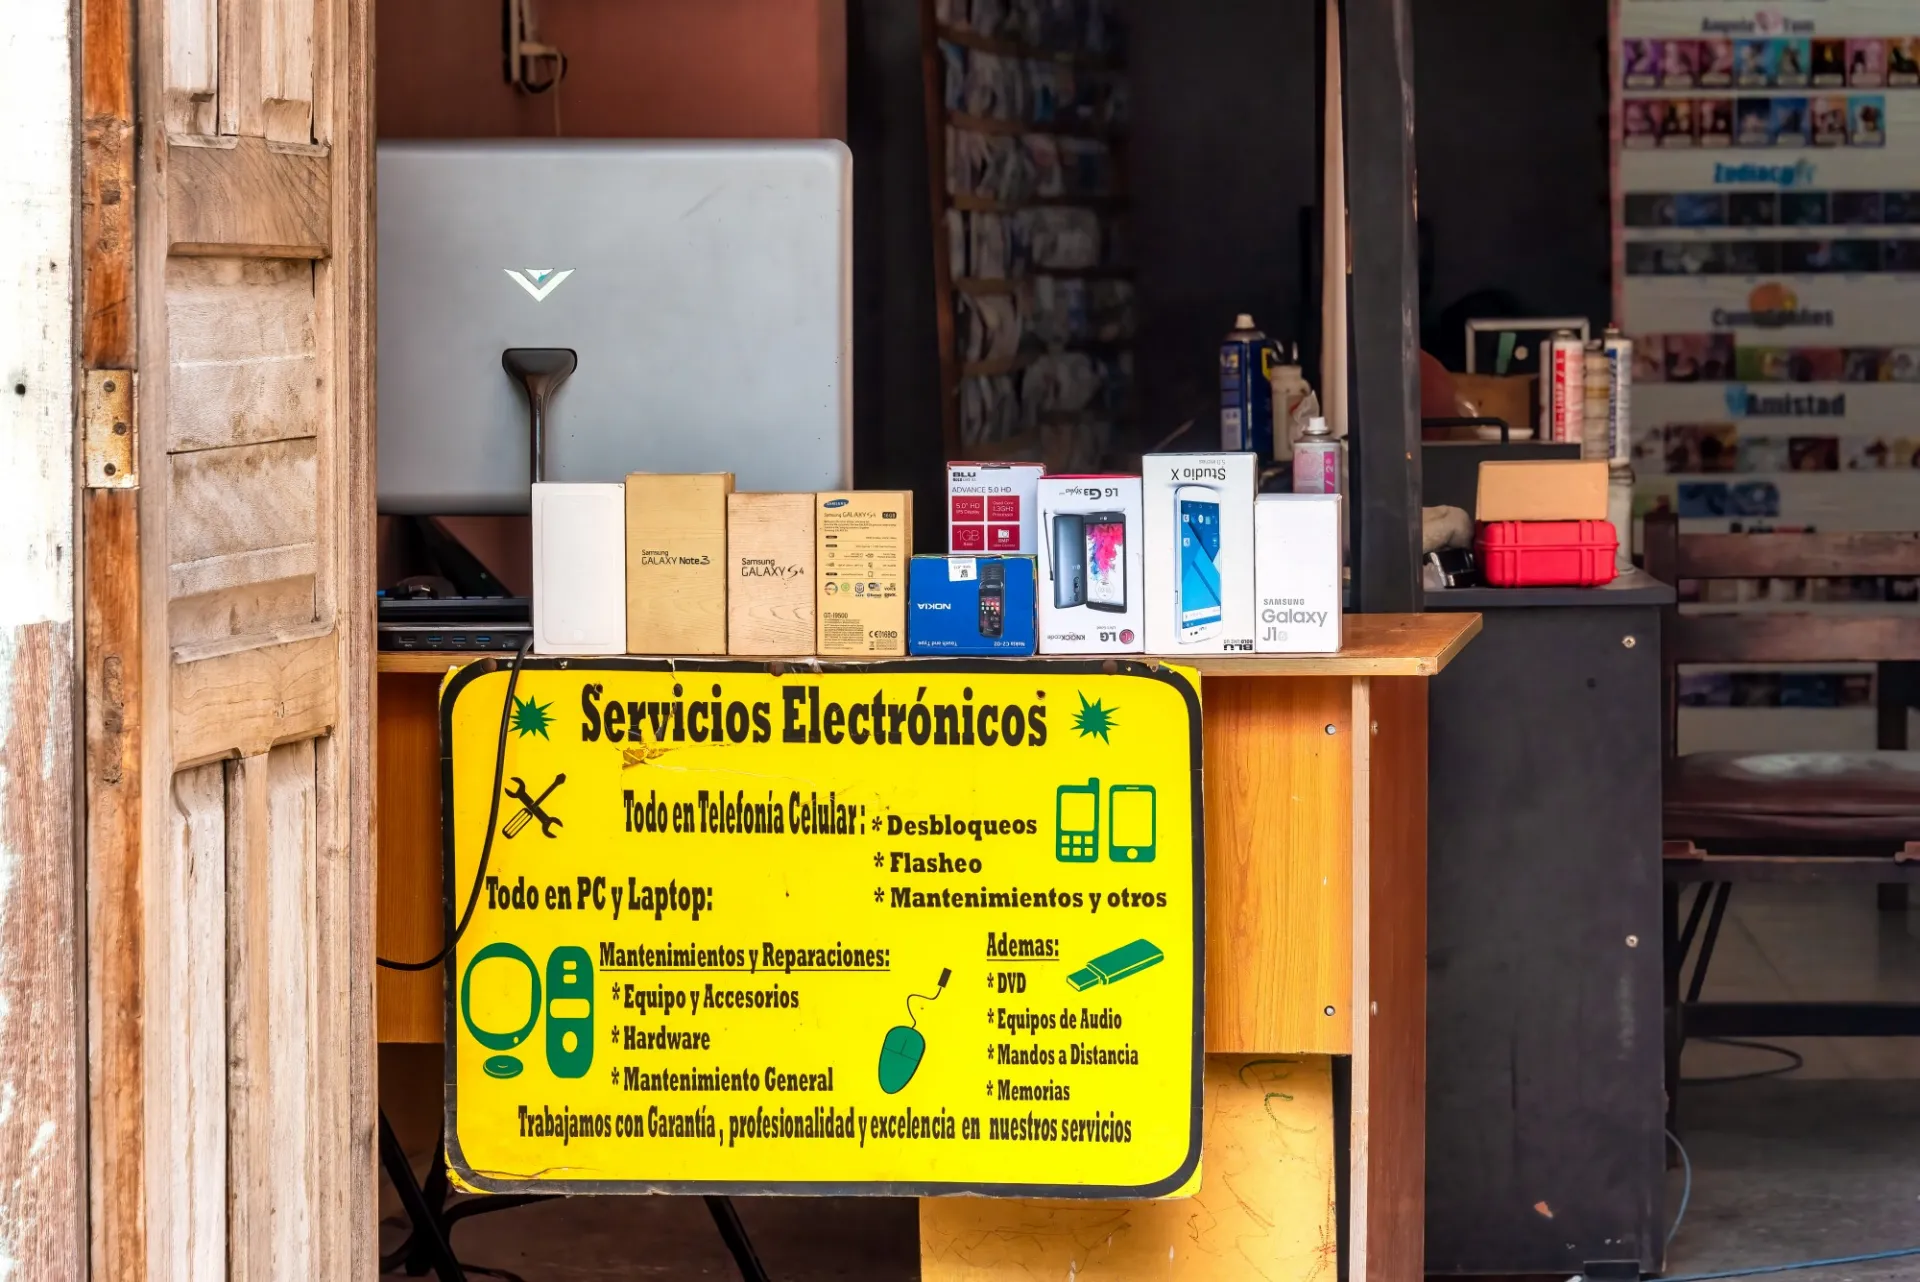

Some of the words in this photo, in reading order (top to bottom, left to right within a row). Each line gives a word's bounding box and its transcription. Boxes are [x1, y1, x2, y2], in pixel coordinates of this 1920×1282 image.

[1746, 393, 1845, 416] Amistad
[1171, 468, 1180, 480] X
[1183, 467, 1226, 480] Studio
[1083, 488, 1102, 500] G3
[1105, 488, 1119, 497] LG
[957, 530, 980, 541] 1GB
[641, 549, 669, 557] Samsung
[641, 557, 677, 565] GALAXY
[741, 557, 775, 567] Samsung
[741, 566, 786, 577] GALAXY
[1261, 609, 1328, 626] Galaxy
[1100, 632, 1117, 642] LG
[582, 684, 771, 743] Servicios
[783, 686, 1046, 746] Electrónicos
[624, 790, 667, 833] Todo
[673, 802, 694, 833] en
[699, 790, 784, 833] Telefonía
[888, 815, 1036, 841] Desbloqueos
[891, 852, 981, 873] Flasheo
[486, 876, 539, 909] Todo
[545, 886, 571, 909] en
[578, 876, 605, 910] PC
[612, 887, 622, 920] y
[629, 877, 712, 921] Laptop:
[891, 887, 1083, 907] Mantenimientos
[1089, 893, 1101, 913] y
[1108, 888, 1166, 907] otros
[987, 932, 1058, 956] Ademas:
[600, 942, 744, 967] Mantenimientos
[749, 949, 759, 974] y
[763, 942, 890, 974] Reparaciones:
[998, 973, 1026, 993] DVD
[624, 984, 685, 1015] Equipo
[690, 991, 699, 1015] y
[704, 984, 798, 1008] Accesorios
[998, 1008, 1056, 1035] Equipos
[1060, 1008, 1076, 1029] de
[1081, 1008, 1121, 1028] Audio
[624, 1026, 710, 1050] Hardware
[998, 1044, 1054, 1065] Mandos
[1059, 1050, 1066, 1064] a
[1071, 1042, 1138, 1064] Distancia
[624, 1067, 759, 1091] Mantenimiento
[765, 1067, 833, 1091] General
[998, 1080, 1069, 1100] Memorias
[519, 1105, 611, 1146] Trabajamos
[616, 1115, 643, 1137] con
[730, 1106, 854, 1147] profesionalidad
[859, 1116, 867, 1148] y
[871, 1107, 955, 1139] excelencia
[962, 1117, 980, 1139] en
[990, 1111, 1057, 1141] nuestros
[1062, 1111, 1131, 1142] servicios
